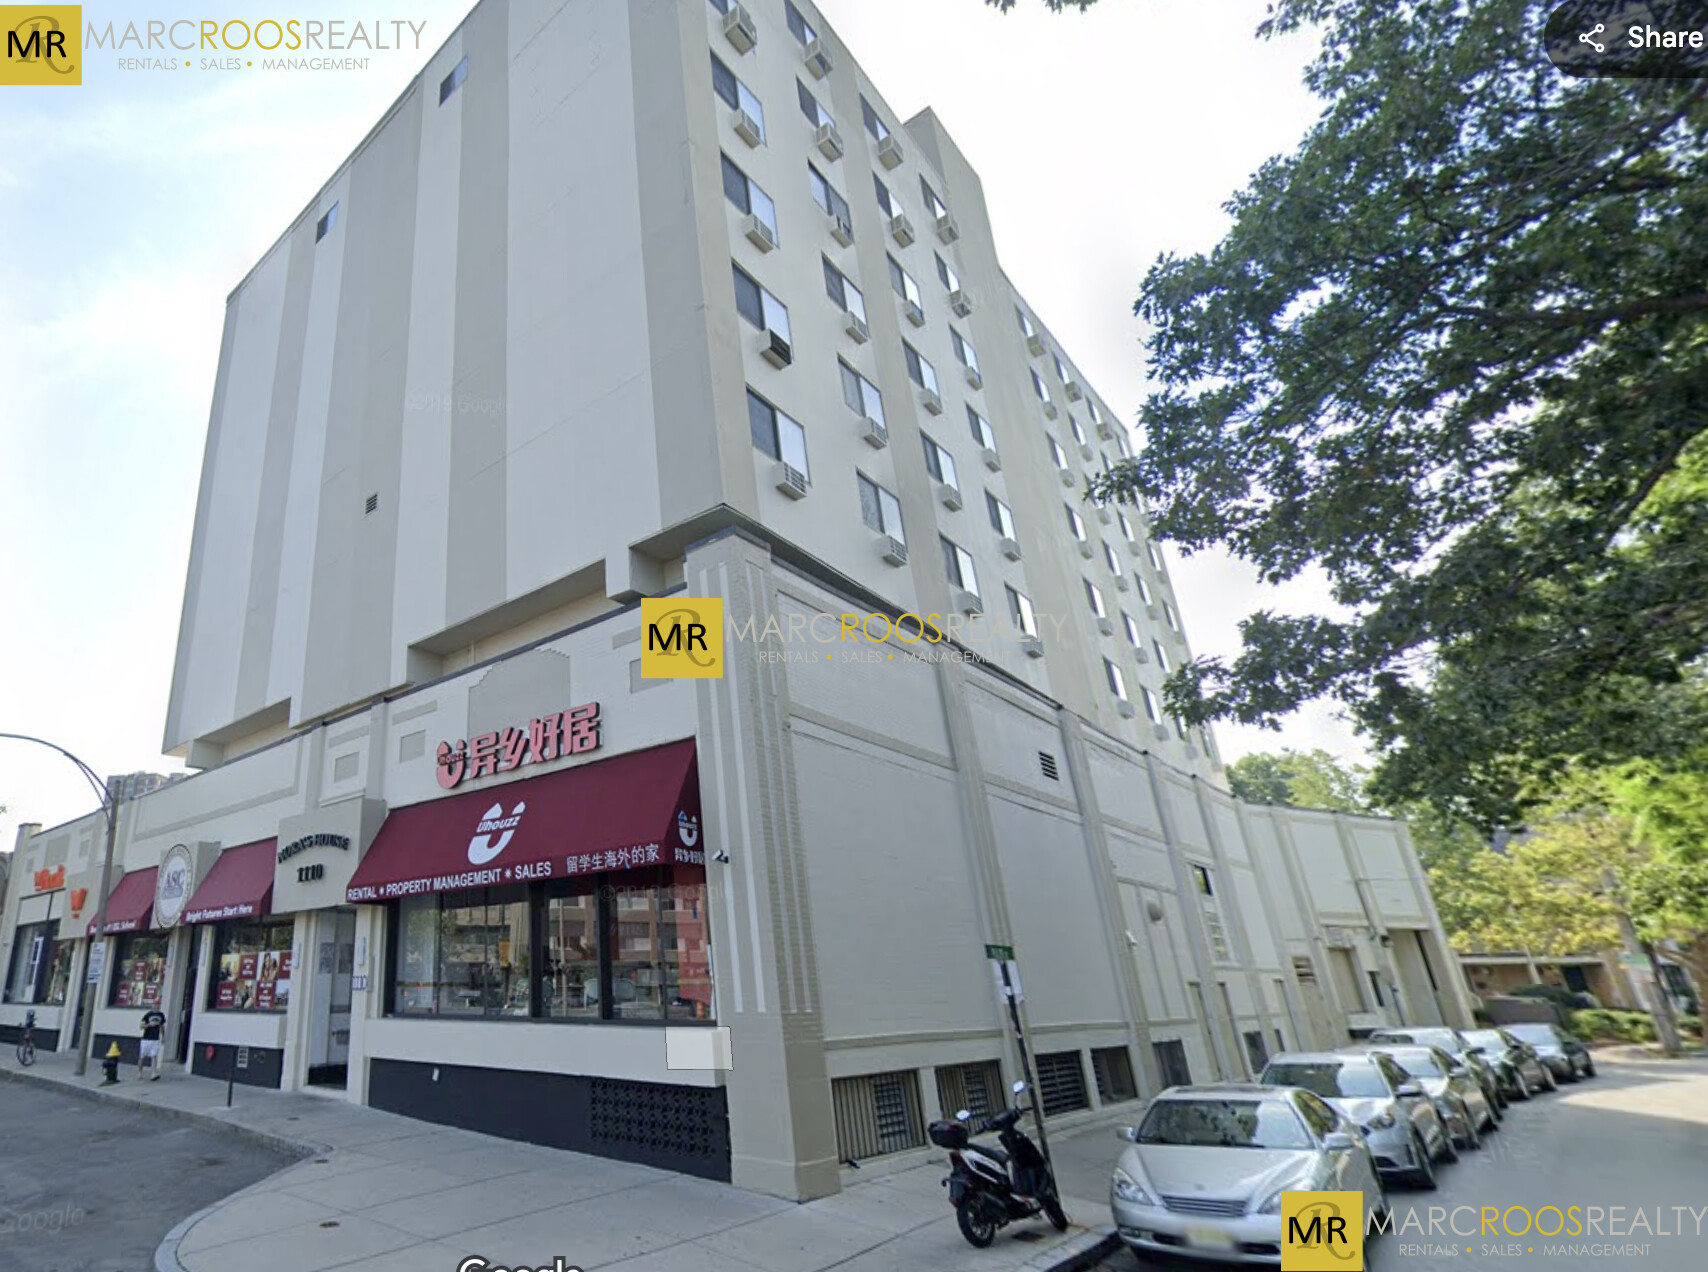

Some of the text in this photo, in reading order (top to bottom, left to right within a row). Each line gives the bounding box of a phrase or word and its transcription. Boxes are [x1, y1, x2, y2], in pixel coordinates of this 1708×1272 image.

[470, 701, 600, 778] 异乡好居
[297, 863, 324, 882] 1110
[566, 842, 660, 874] 留学生海外的家
[347, 861, 552, 900] RENTAL PROPERTY MANAGEMENT SALES
[223, 906, 237, 916] Start
